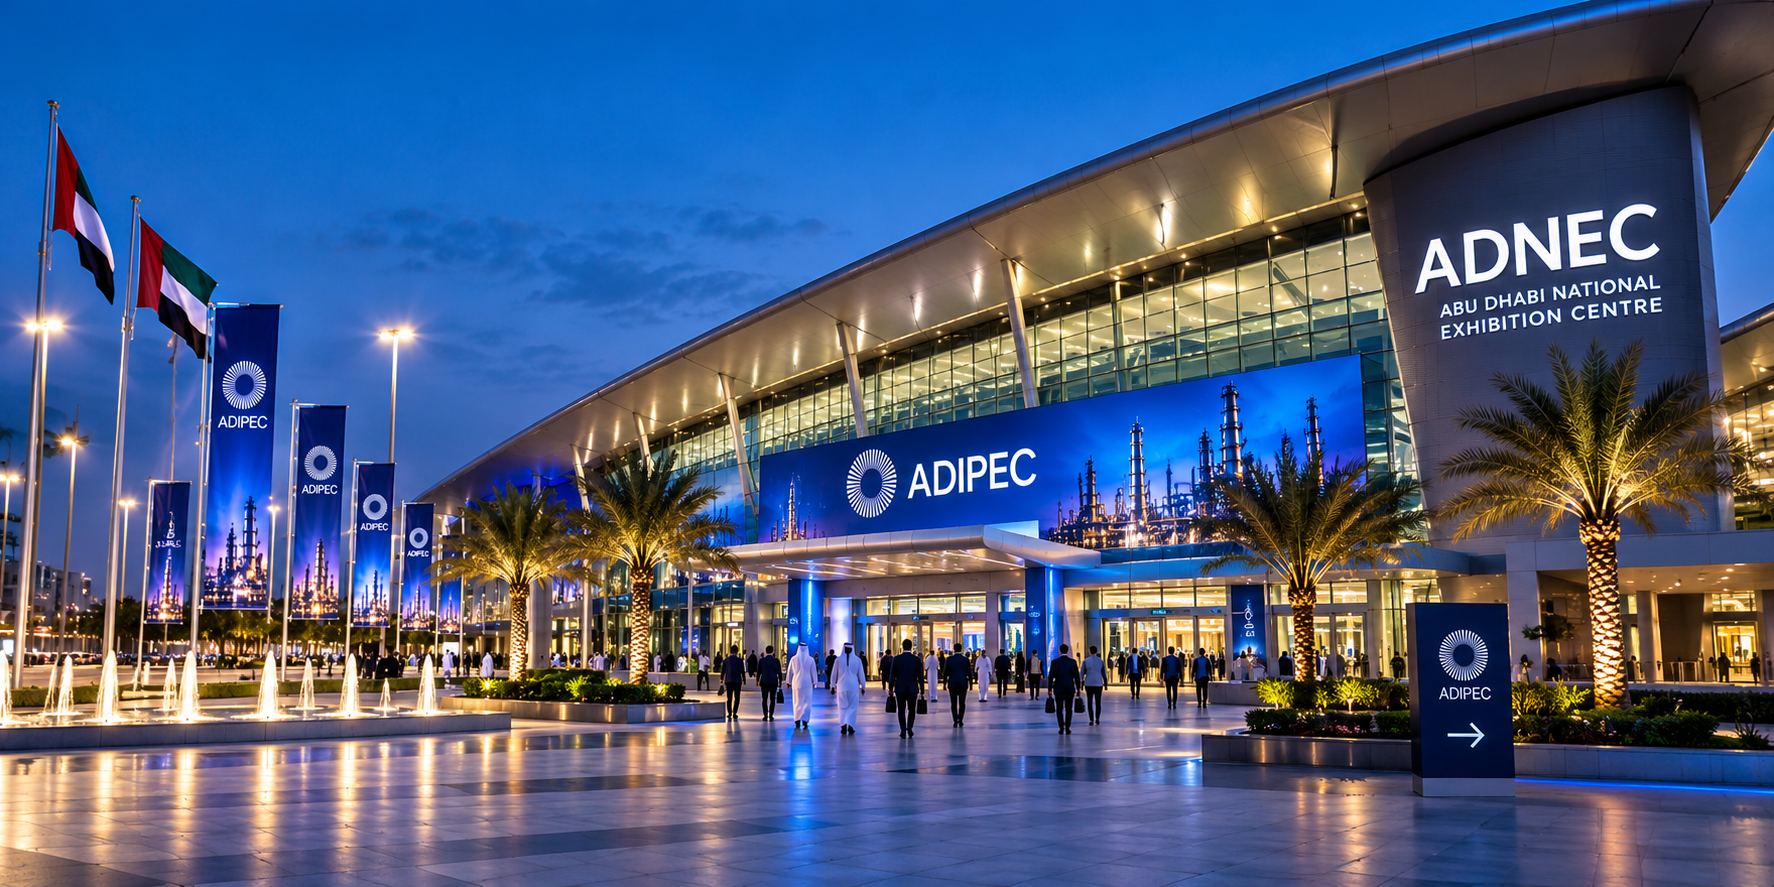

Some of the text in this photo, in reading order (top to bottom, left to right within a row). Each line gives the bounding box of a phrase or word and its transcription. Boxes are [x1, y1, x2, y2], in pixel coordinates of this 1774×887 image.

[1414, 203, 1661, 294] ADNEC
[1439, 274, 1661, 319] ABU DHABI NATIONAL
[1440, 296, 1663, 341] EXHIBITION CENTRE
[217, 415, 268, 429] ADIPEC
[907, 447, 1038, 500] ADIPEC
[301, 484, 338, 495] ADIPEC
[360, 522, 389, 532] ADIPEC
[1438, 686, 1492, 701] ADIPEC
